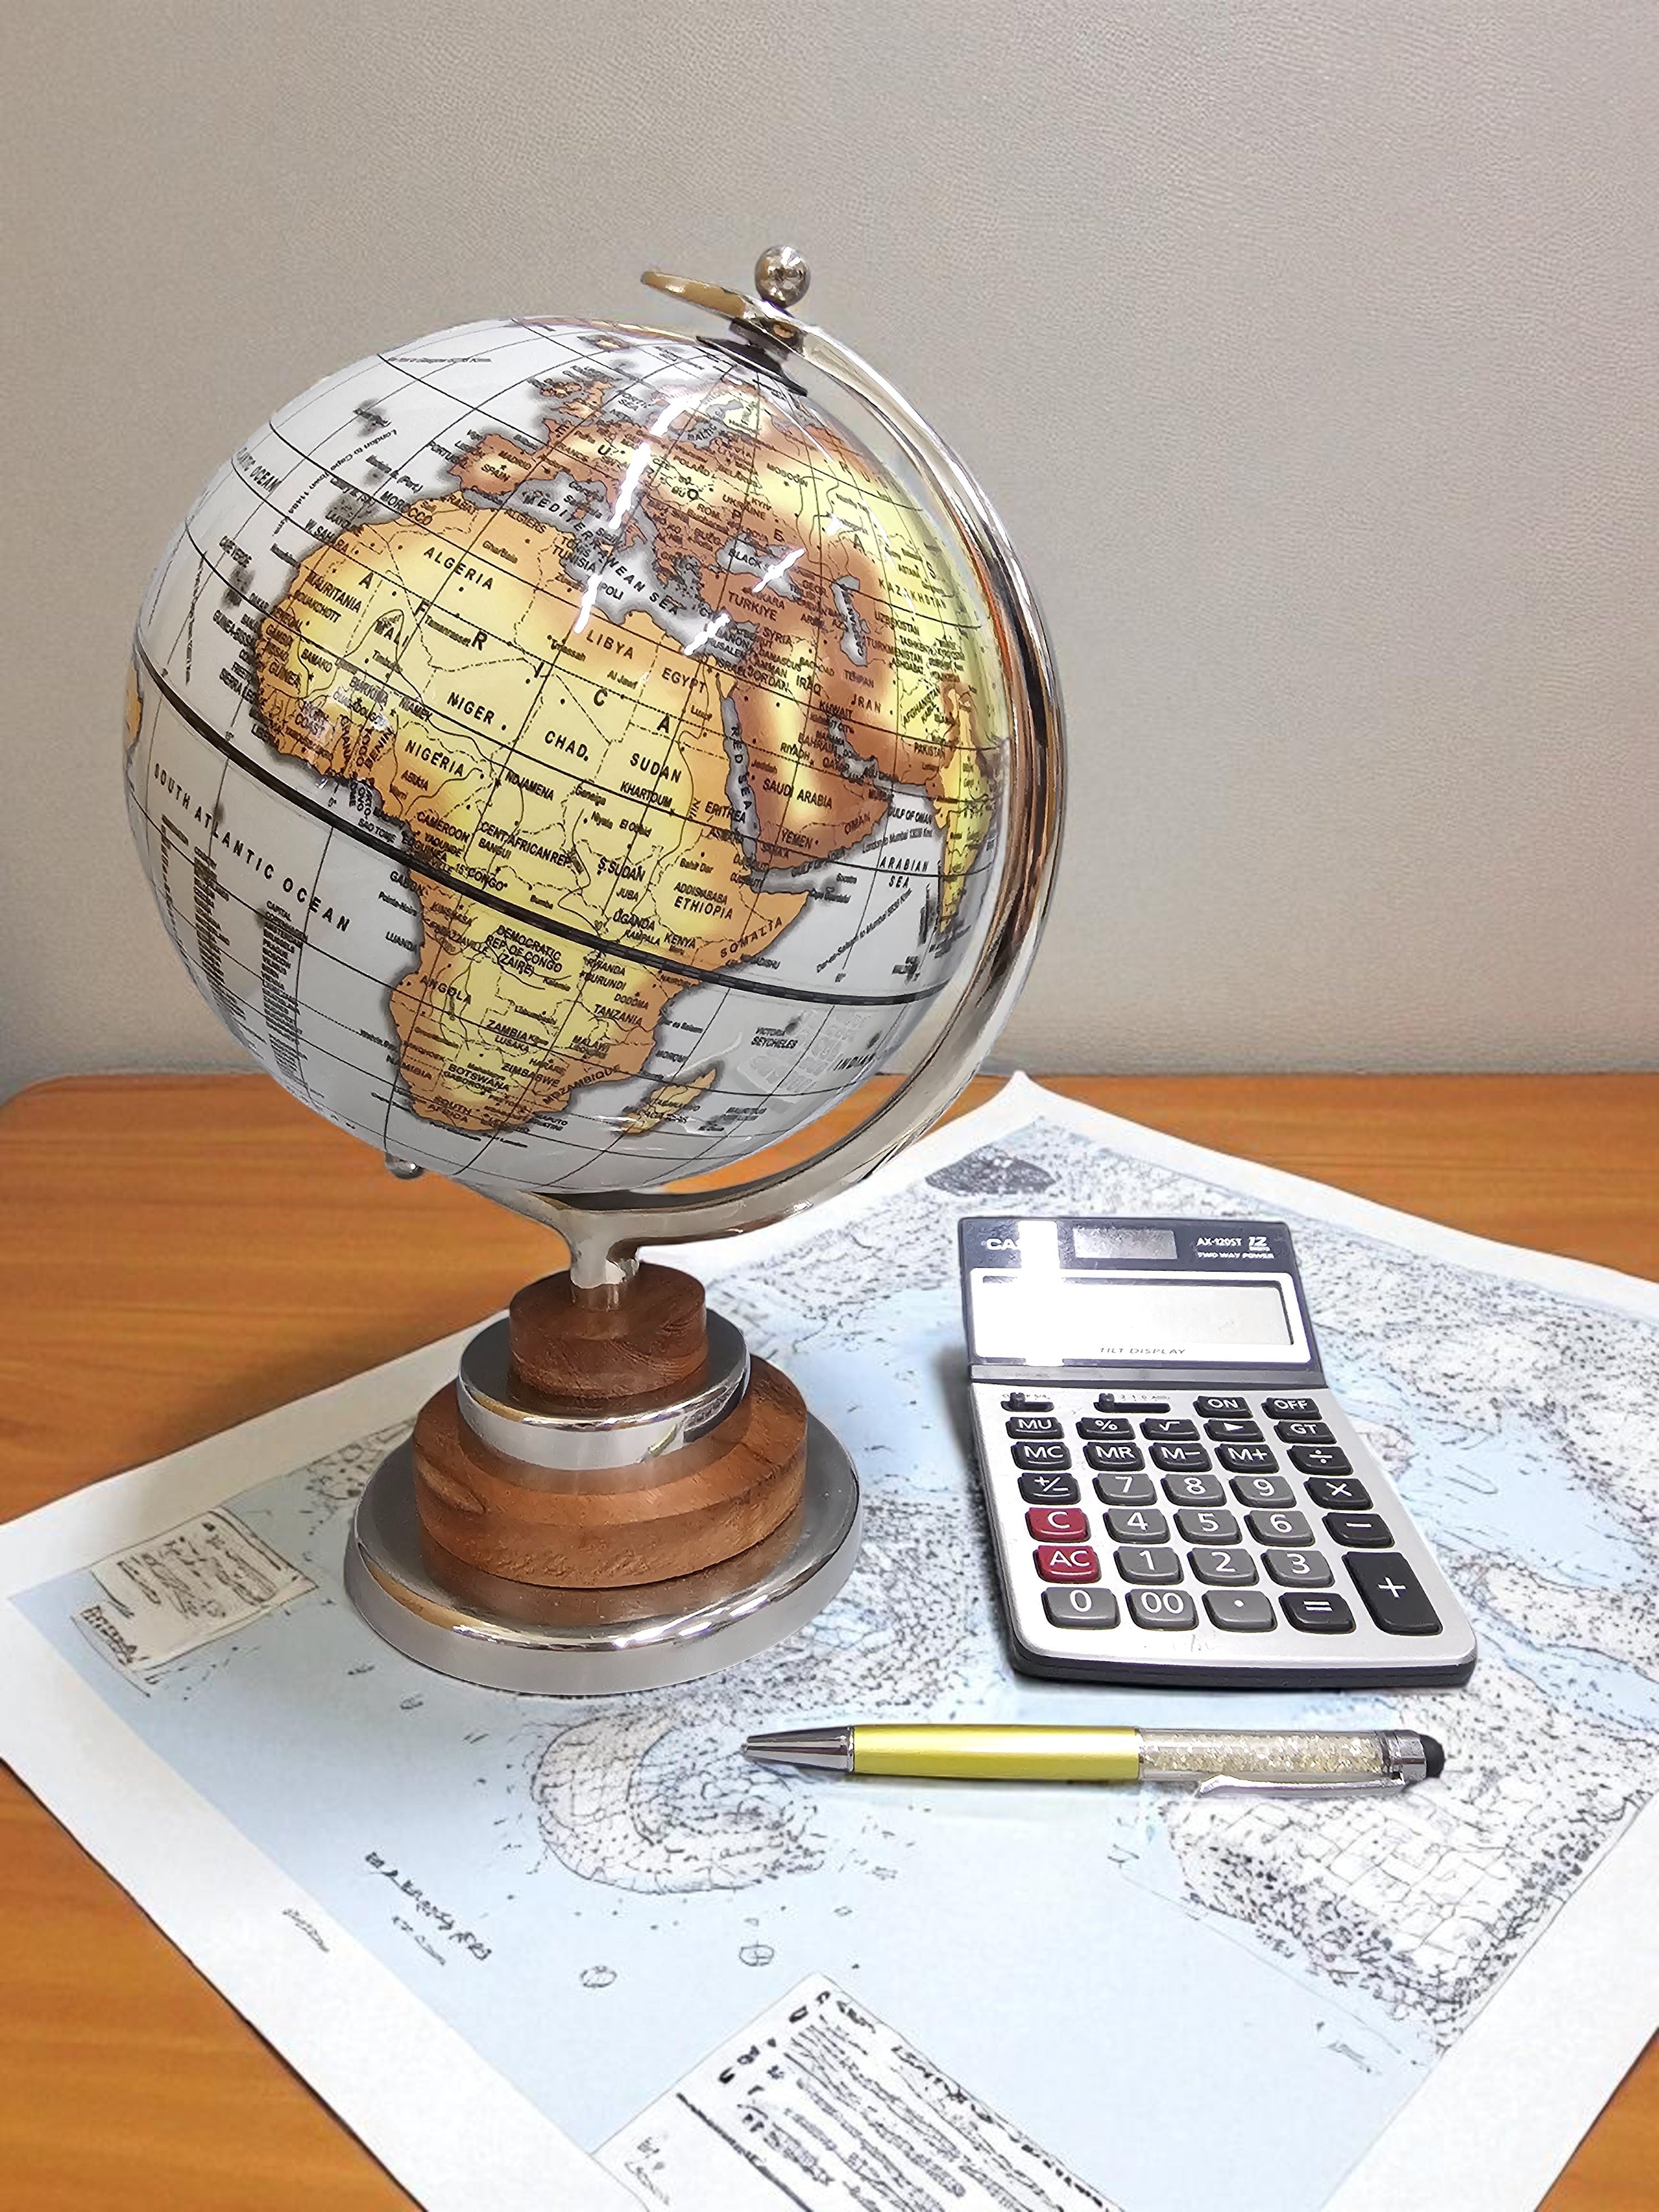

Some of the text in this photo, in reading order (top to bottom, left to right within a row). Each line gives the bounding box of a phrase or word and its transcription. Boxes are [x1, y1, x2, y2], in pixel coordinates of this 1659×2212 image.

[423, 547, 494, 590] ALGERIA
[586, 629, 633, 659] LIBYA
[661, 667, 707, 693] EGYPT
[796, 675, 823, 697] IRAQ
[447, 692, 496, 725] NIGER
[405, 739, 464, 777] NIGERIA
[629, 753, 682, 784] SUDAN
[763, 778, 832, 809] SAUDI ARABIA
[195, 806, 275, 880] ATLANTIC
[283, 877, 351, 932] OCEAN
[889, 875, 910, 889] SEA
[674, 896, 733, 920] ETHIOPIA
[593, 1003, 643, 1026] TANZANIA
[1196, 1238, 1242, 1246] AX-120ST
[1208, 1399, 1238, 1409] ON
[1274, 1400, 1307, 1410] OFF
[1018, 1419, 1052, 1430] MU
[1290, 1424, 1316, 1434] GT
[1024, 1446, 1063, 1458] MC
[1095, 1446, 1135, 1459] MR
[1228, 1447, 1267, 1460] M+
[1115, 1476, 1133, 1493] 7
[1183, 1477, 1206, 1495] 8
[1253, 1479, 1275, 1496] 9
[1047, 1511, 1071, 1529] C
[1127, 1512, 1148, 1531] 4
[1197, 1512, 1219, 1532] 5
[1270, 1514, 1292, 1532] 6
[1050, 1550, 1090, 1567] AC
[1139, 1550, 1155, 1570] 1
[1212, 1552, 1236, 1572] 2
[1287, 1553, 1310, 1574] 3
[1070, 1590, 1092, 1612] 0
[1141, 1592, 1184, 1614] 00
